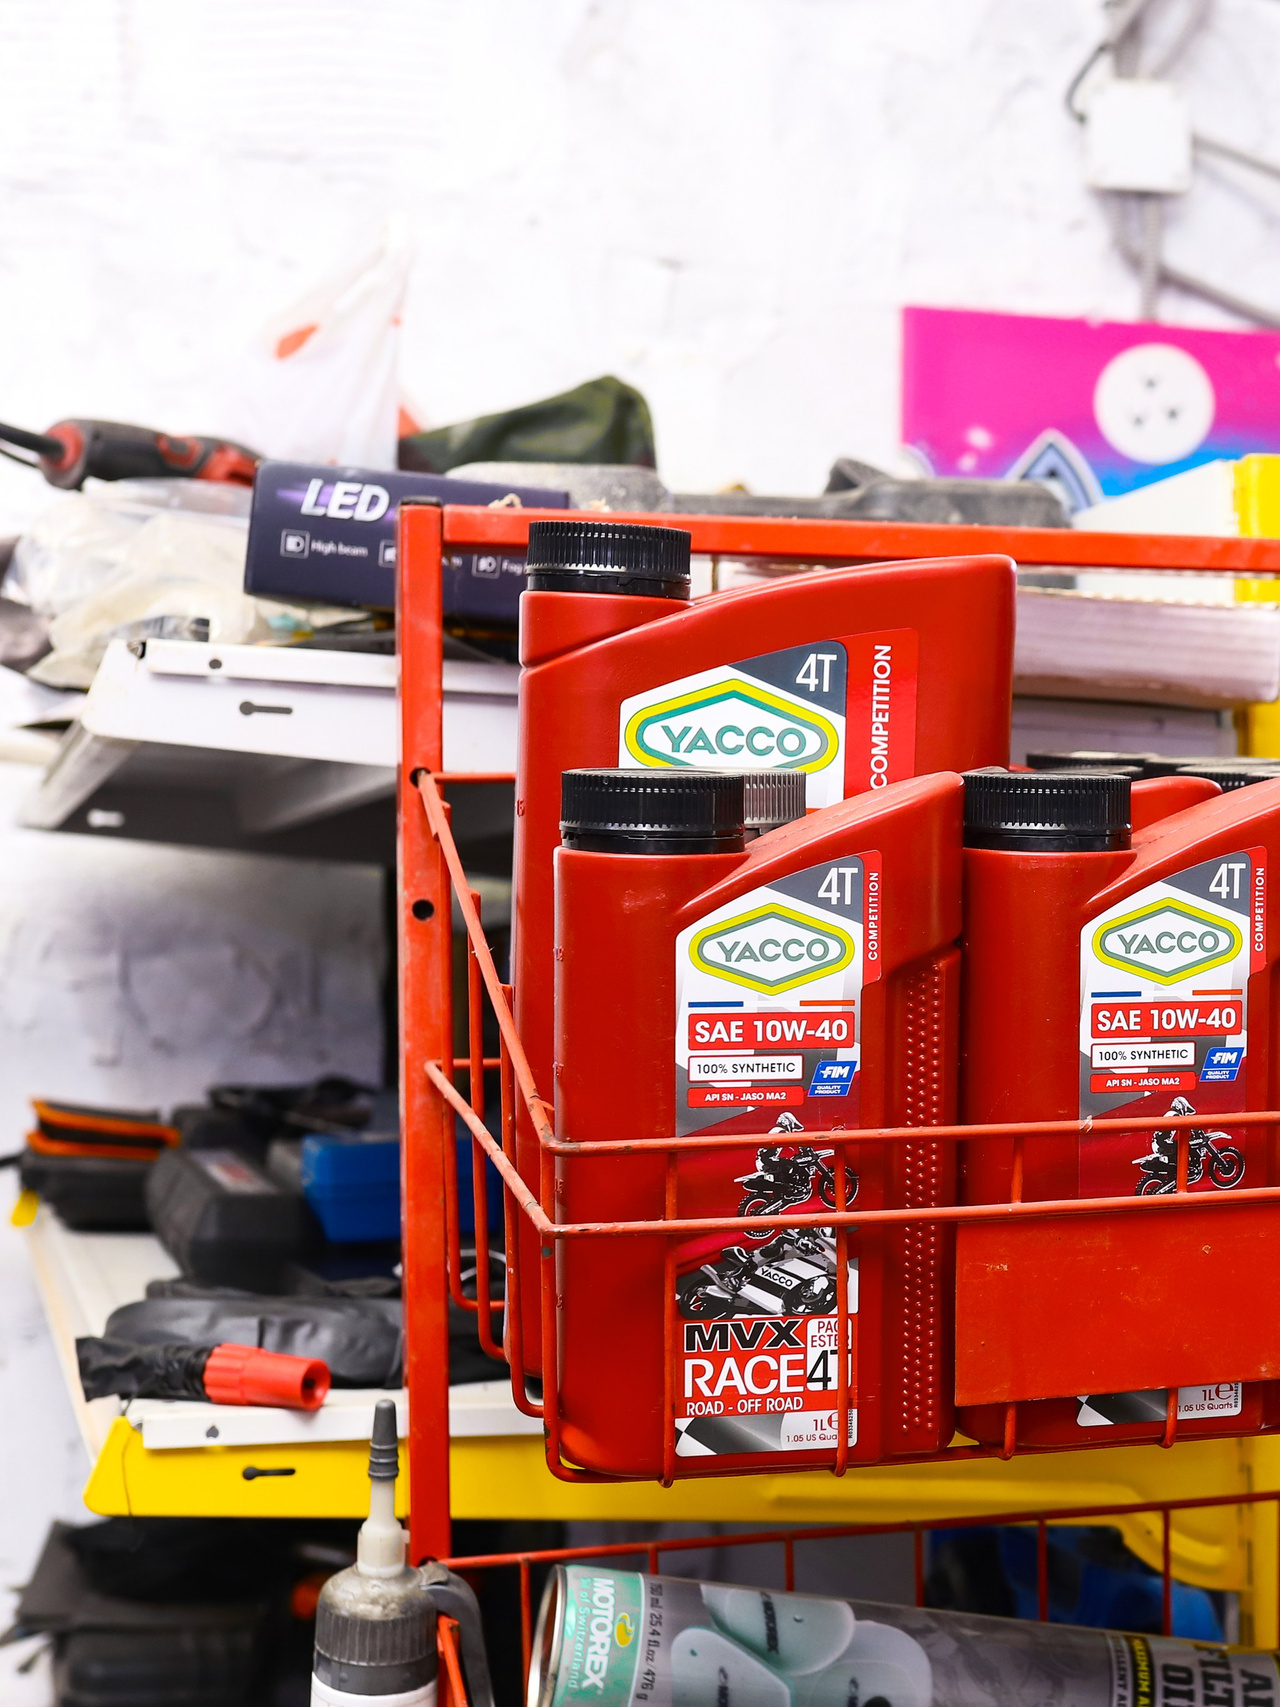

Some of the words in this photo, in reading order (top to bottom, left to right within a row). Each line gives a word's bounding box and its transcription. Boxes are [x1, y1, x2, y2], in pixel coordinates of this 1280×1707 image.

[301, 478, 390, 523] LED
[311, 540, 337, 556] High
[338, 540, 368, 557] beam
[796, 653, 838, 693] 4T
[870, 645, 892, 789] COMPETITION
[661, 724, 807, 757] YACCO
[817, 867, 858, 905] 4T
[1209, 863, 1246, 899] 4T
[868, 872, 879, 960] COMPETITION
[1254, 867, 1265, 951] COMPETITION
[717, 938, 829, 962] YACCO
[1117, 931, 1220, 954] YACCO
[694, 1020, 743, 1042] SAE
[753, 1019, 848, 1042] 10W-40
[1097, 1010, 1141, 1031] SAE
[1150, 1008, 1236, 1030] 10W-40
[1099, 1050, 1127, 1061] 100%
[1130, 1049, 1189, 1060] SYNTHETIC
[1210, 1052, 1238, 1064] FIM
[697, 1063, 728, 1074] 100%
[732, 1062, 796, 1073] SYNTHETIC
[820, 1065, 850, 1078] FIM
[1106, 1079, 1120, 1087] API
[1138, 1078, 1160, 1086] JASO
[1161, 1077, 1180, 1085] MA2
[705, 1093, 720, 1101] API
[721, 1093, 734, 1101] SN
[741, 1092, 764, 1101] JASO
[766, 1091, 786, 1100] MA2
[761, 1267, 793, 1287] YACCO
[684, 1319, 805, 1353] MVX
[811, 1334, 850, 1348] ESTE
[684, 1354, 805, 1398] RACE
[686, 1400, 725, 1416] ROAD
[737, 1399, 762, 1413] OFF
[766, 1396, 803, 1412] ROAD
[1202, 1389, 1215, 1401] 1L
[1207, 1402, 1233, 1410] Quarts
[786, 1434, 804, 1443] 1.05
[819, 1433, 838, 1441] Qua
[579, 1590, 591, 1603] of
[582, 1577, 615, 1690] MOTOREX
[568, 1605, 591, 1689] Switzerland
[640, 1668, 656, 1690] 476
[636, 1692, 649, 1701] g
